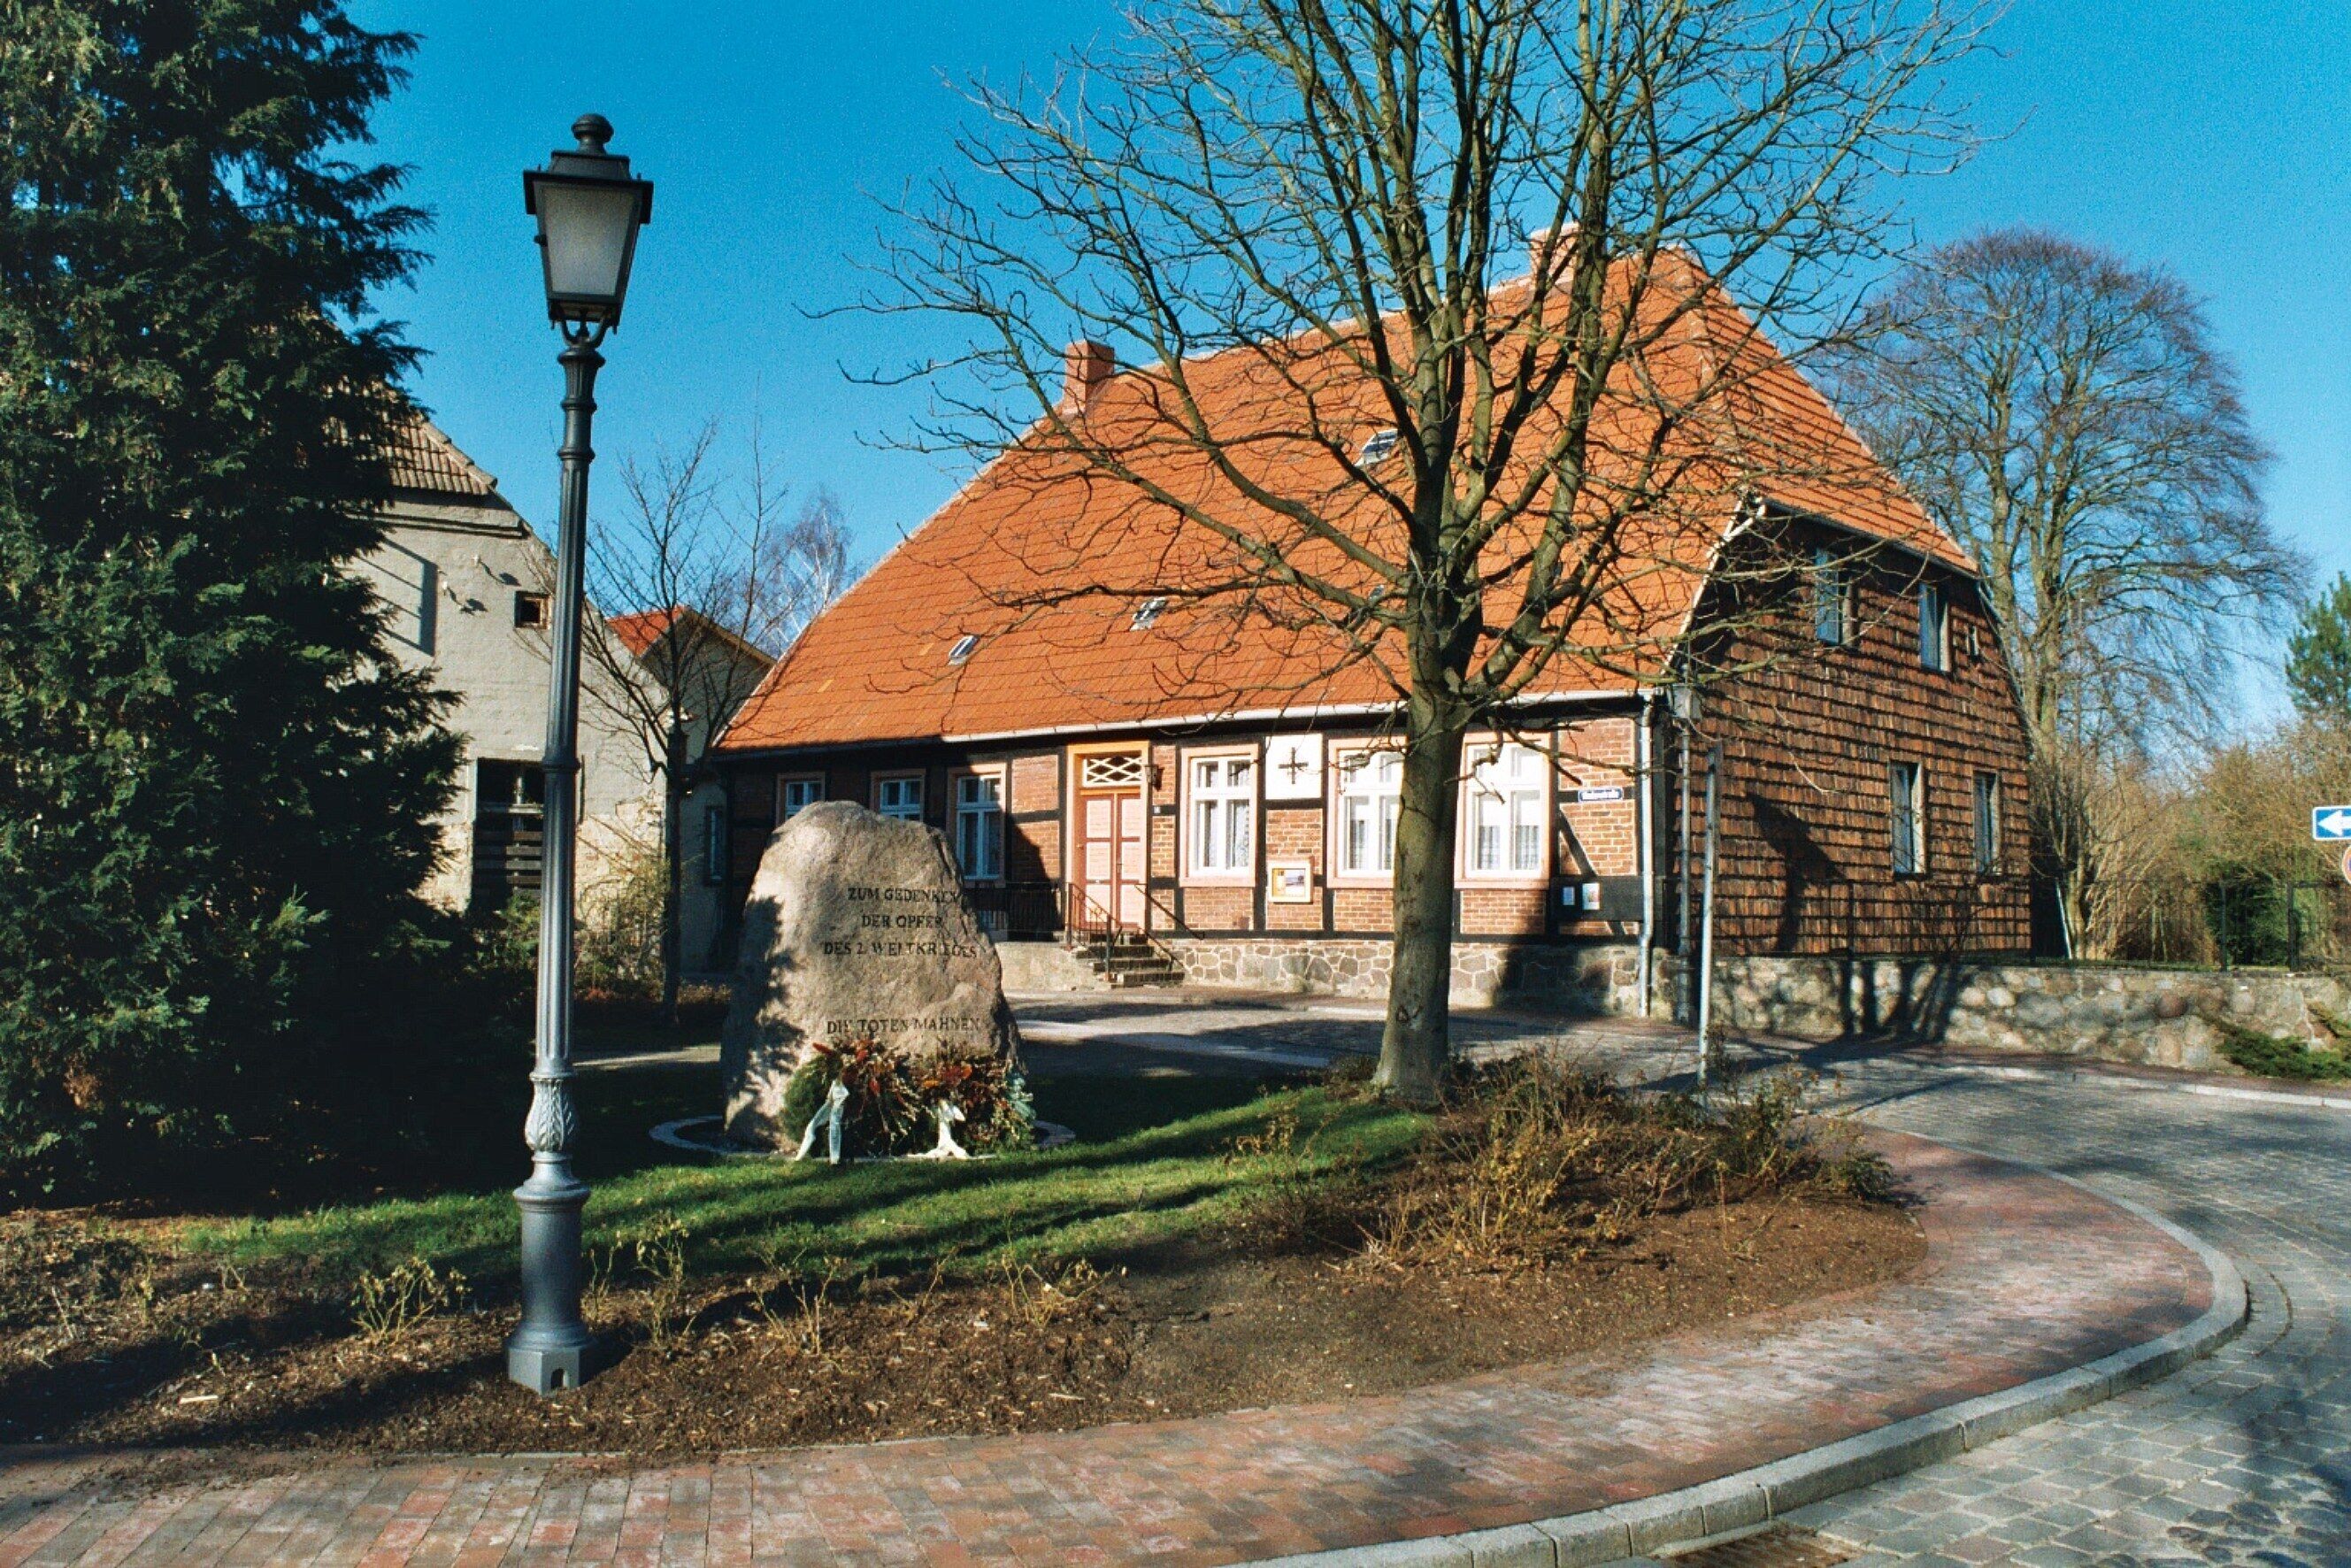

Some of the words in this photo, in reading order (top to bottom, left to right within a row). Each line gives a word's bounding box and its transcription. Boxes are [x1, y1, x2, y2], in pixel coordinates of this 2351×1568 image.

[847, 888, 880, 901] ZUM
[885, 888, 957, 903] GEDENKEN
[862, 915, 890, 927] DER
[896, 915, 943, 928] OPFER
[824, 942, 851, 955] DES
[872, 942, 978, 957] WELTKRIEGES
[827, 1019, 852, 1034] DIE
[857, 1018, 909, 1033] TOTEN
[912, 1018, 980, 1031] MAHNEN
